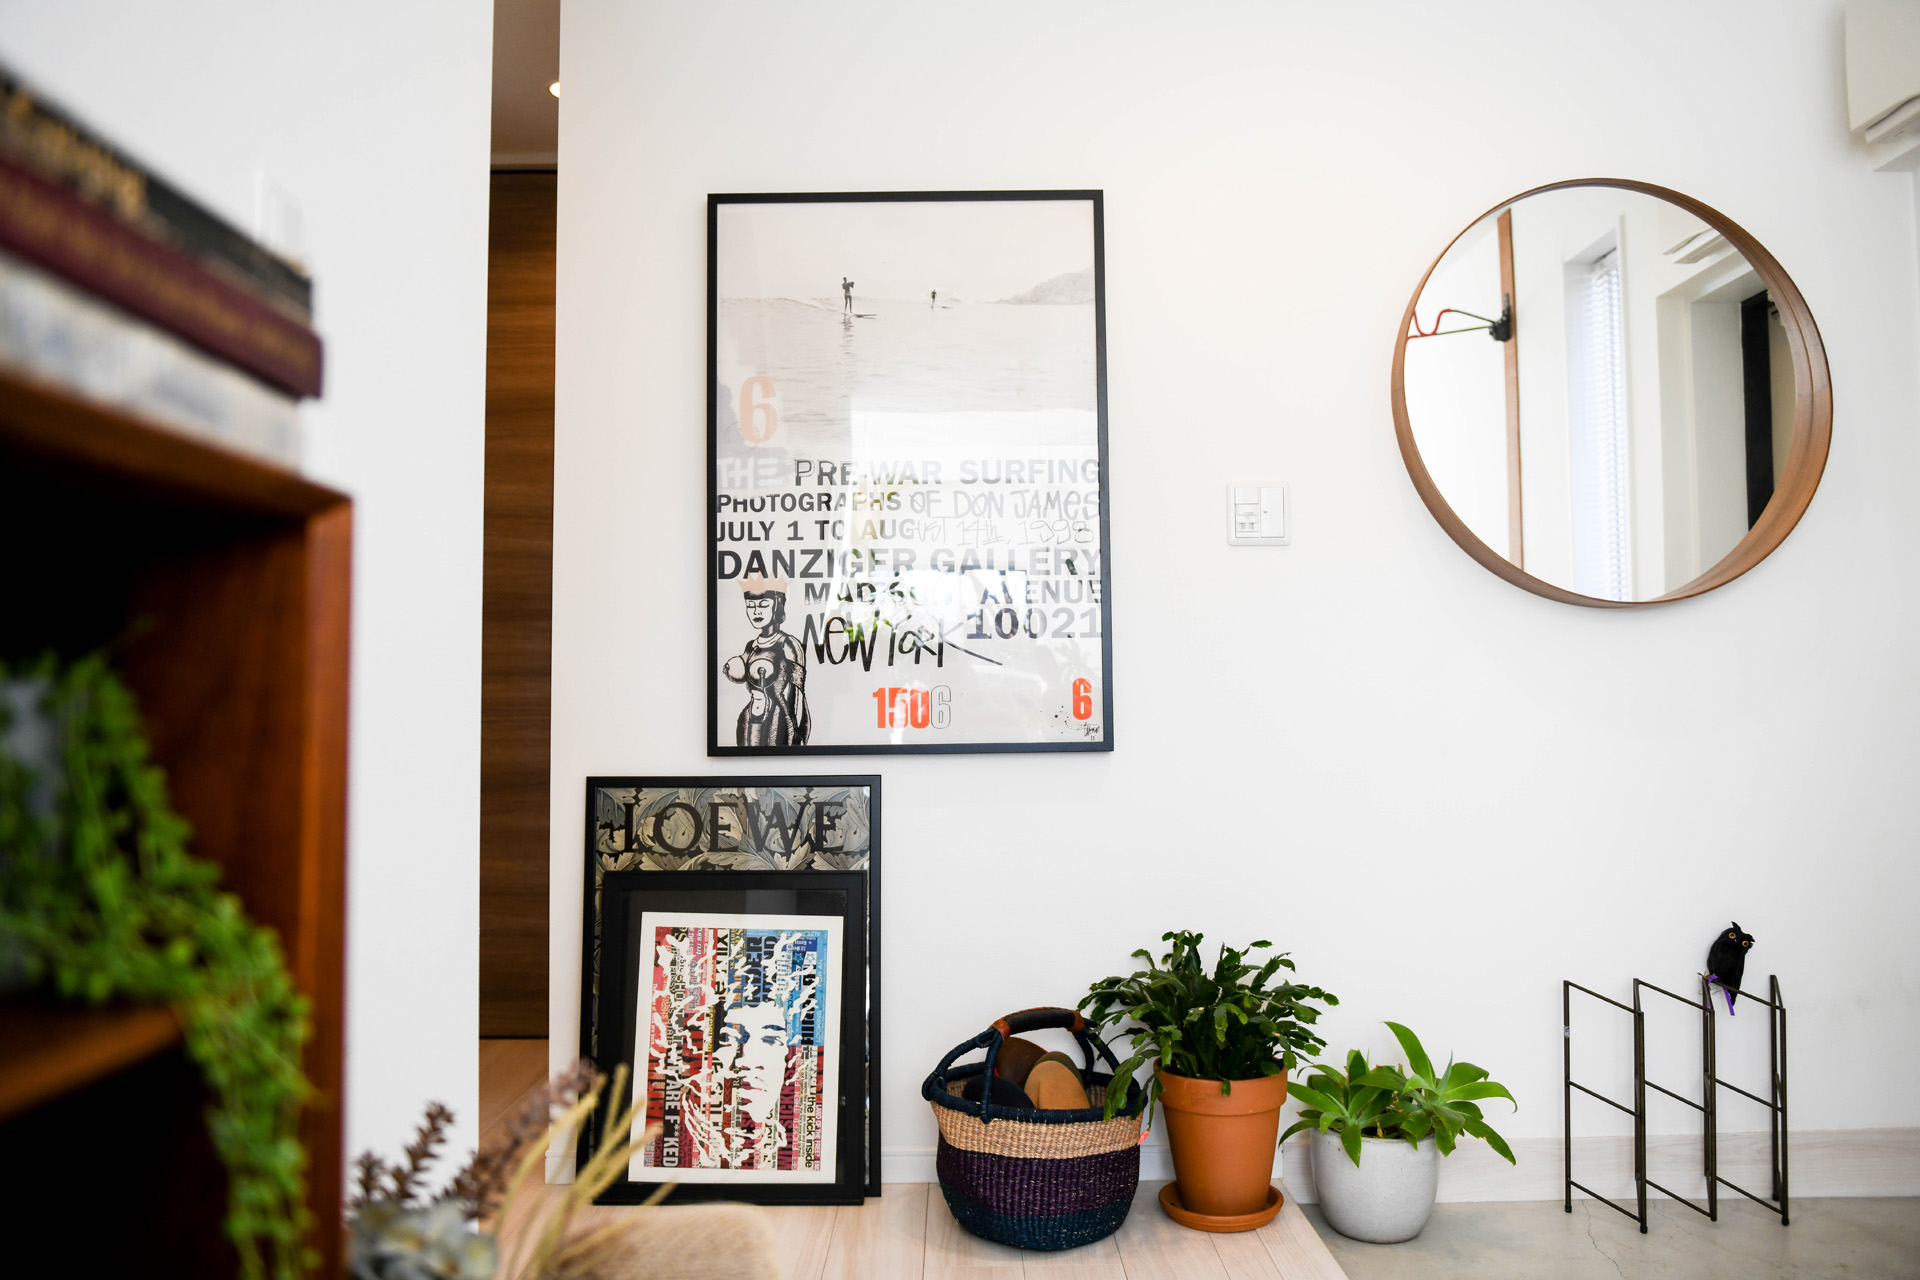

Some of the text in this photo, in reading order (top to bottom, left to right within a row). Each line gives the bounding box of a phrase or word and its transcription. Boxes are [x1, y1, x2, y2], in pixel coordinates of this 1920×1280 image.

[958, 458, 1098, 485] SURFING
[717, 492, 901, 514] PHOTOGRAPHS
[909, 490, 941, 518] OF
[953, 490, 1004, 518] DON
[717, 520, 775, 542] JULY
[786, 520, 804, 541] 1
[814, 520, 846, 542] TO
[717, 547, 1100, 580] DANZIGER GALLERY
[966, 607, 1101, 640] 10021
[1072, 677, 1092, 721] 6
[623, 802, 844, 854] LOEWE
[664, 1079, 682, 1110] ARE
[805, 1096, 816, 1168] the kick inside
